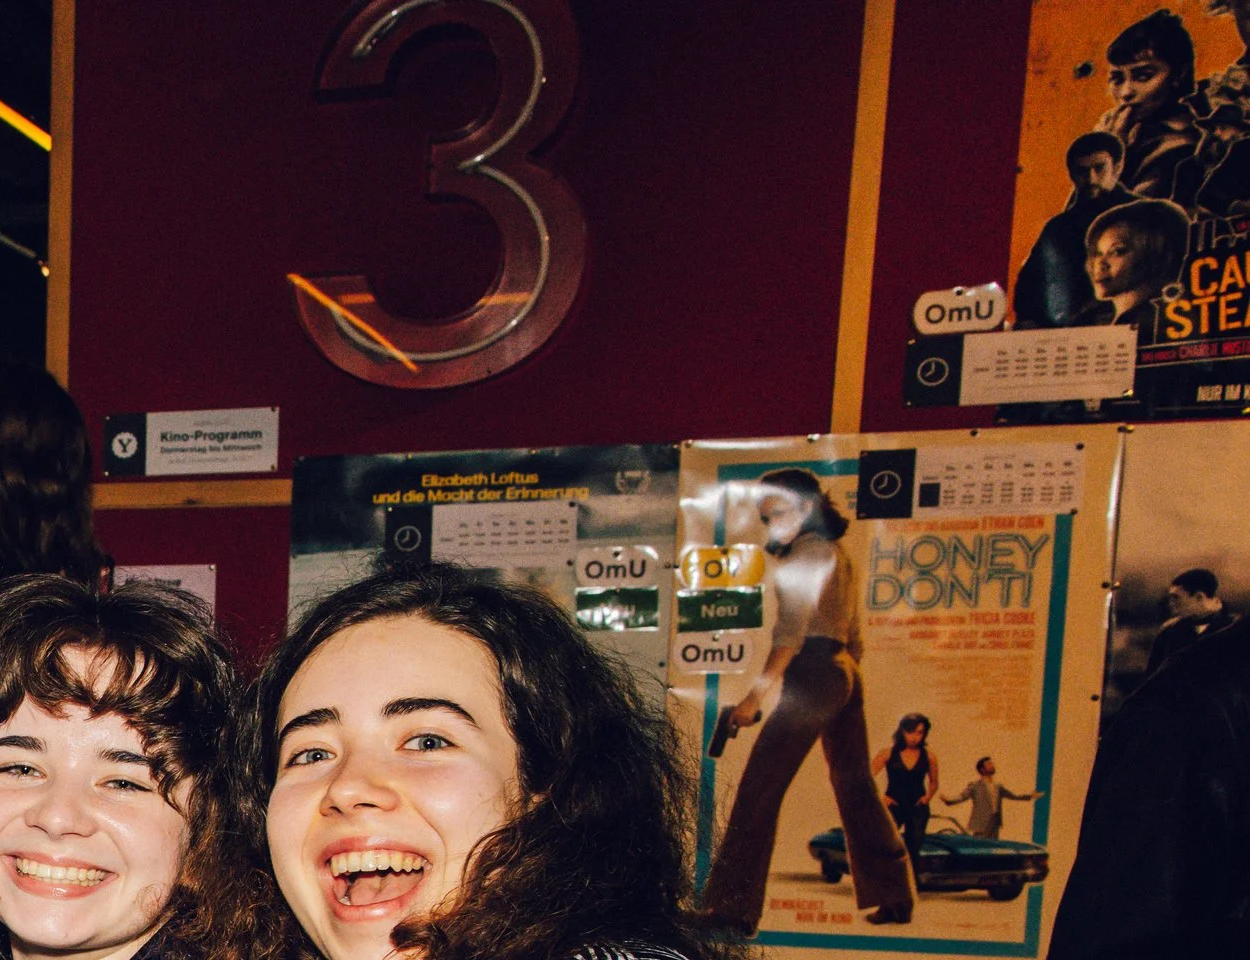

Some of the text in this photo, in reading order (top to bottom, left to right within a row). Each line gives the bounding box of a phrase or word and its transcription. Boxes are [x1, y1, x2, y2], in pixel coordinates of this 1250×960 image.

[296, 0, 588, 389] 3
[1190, 252, 1250, 297] CA
[926, 300, 993, 323] OmU
[1165, 293, 1250, 339] STE
[161, 429, 263, 445] Kino-Programm
[421, 472, 538, 487] Elizabeth Loftus
[373, 486, 590, 504] und die Macht der Erinnerung
[871, 533, 1050, 575] HONEY
[585, 559, 646, 578] OmU
[701, 604, 738, 618] Neu
[681, 644, 744, 663] OmU
